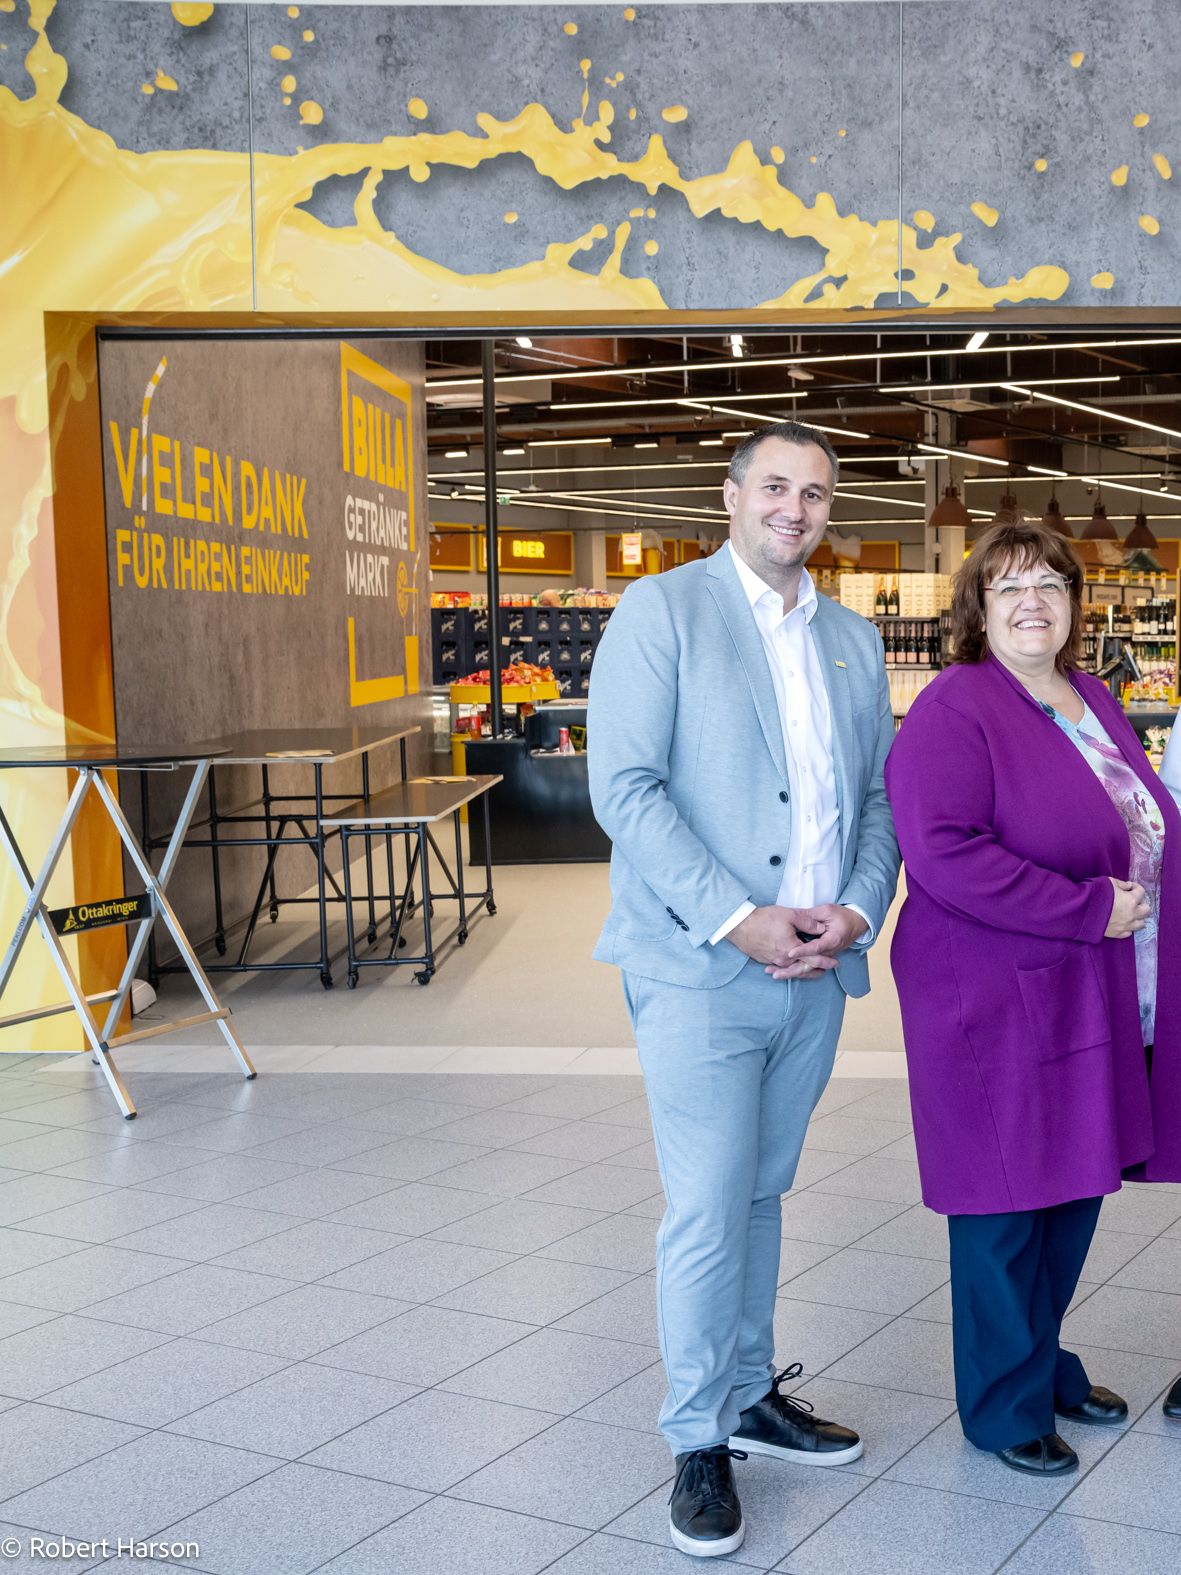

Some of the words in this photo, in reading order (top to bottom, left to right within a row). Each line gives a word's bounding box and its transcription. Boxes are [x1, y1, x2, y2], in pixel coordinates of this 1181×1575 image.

[352, 394, 407, 492] BILLA
[109, 420, 233, 526] VIELEN
[240, 459, 309, 539] DANK
[344, 493, 408, 551] GETRÄNKE
[512, 540, 545, 559] BIER
[115, 515, 168, 590] FÜR
[172, 536, 237, 593] IHREN
[240, 546, 311, 596] EINKAUF
[345, 550, 390, 597] MARKT
[79, 901, 138, 921] Ottakringer
